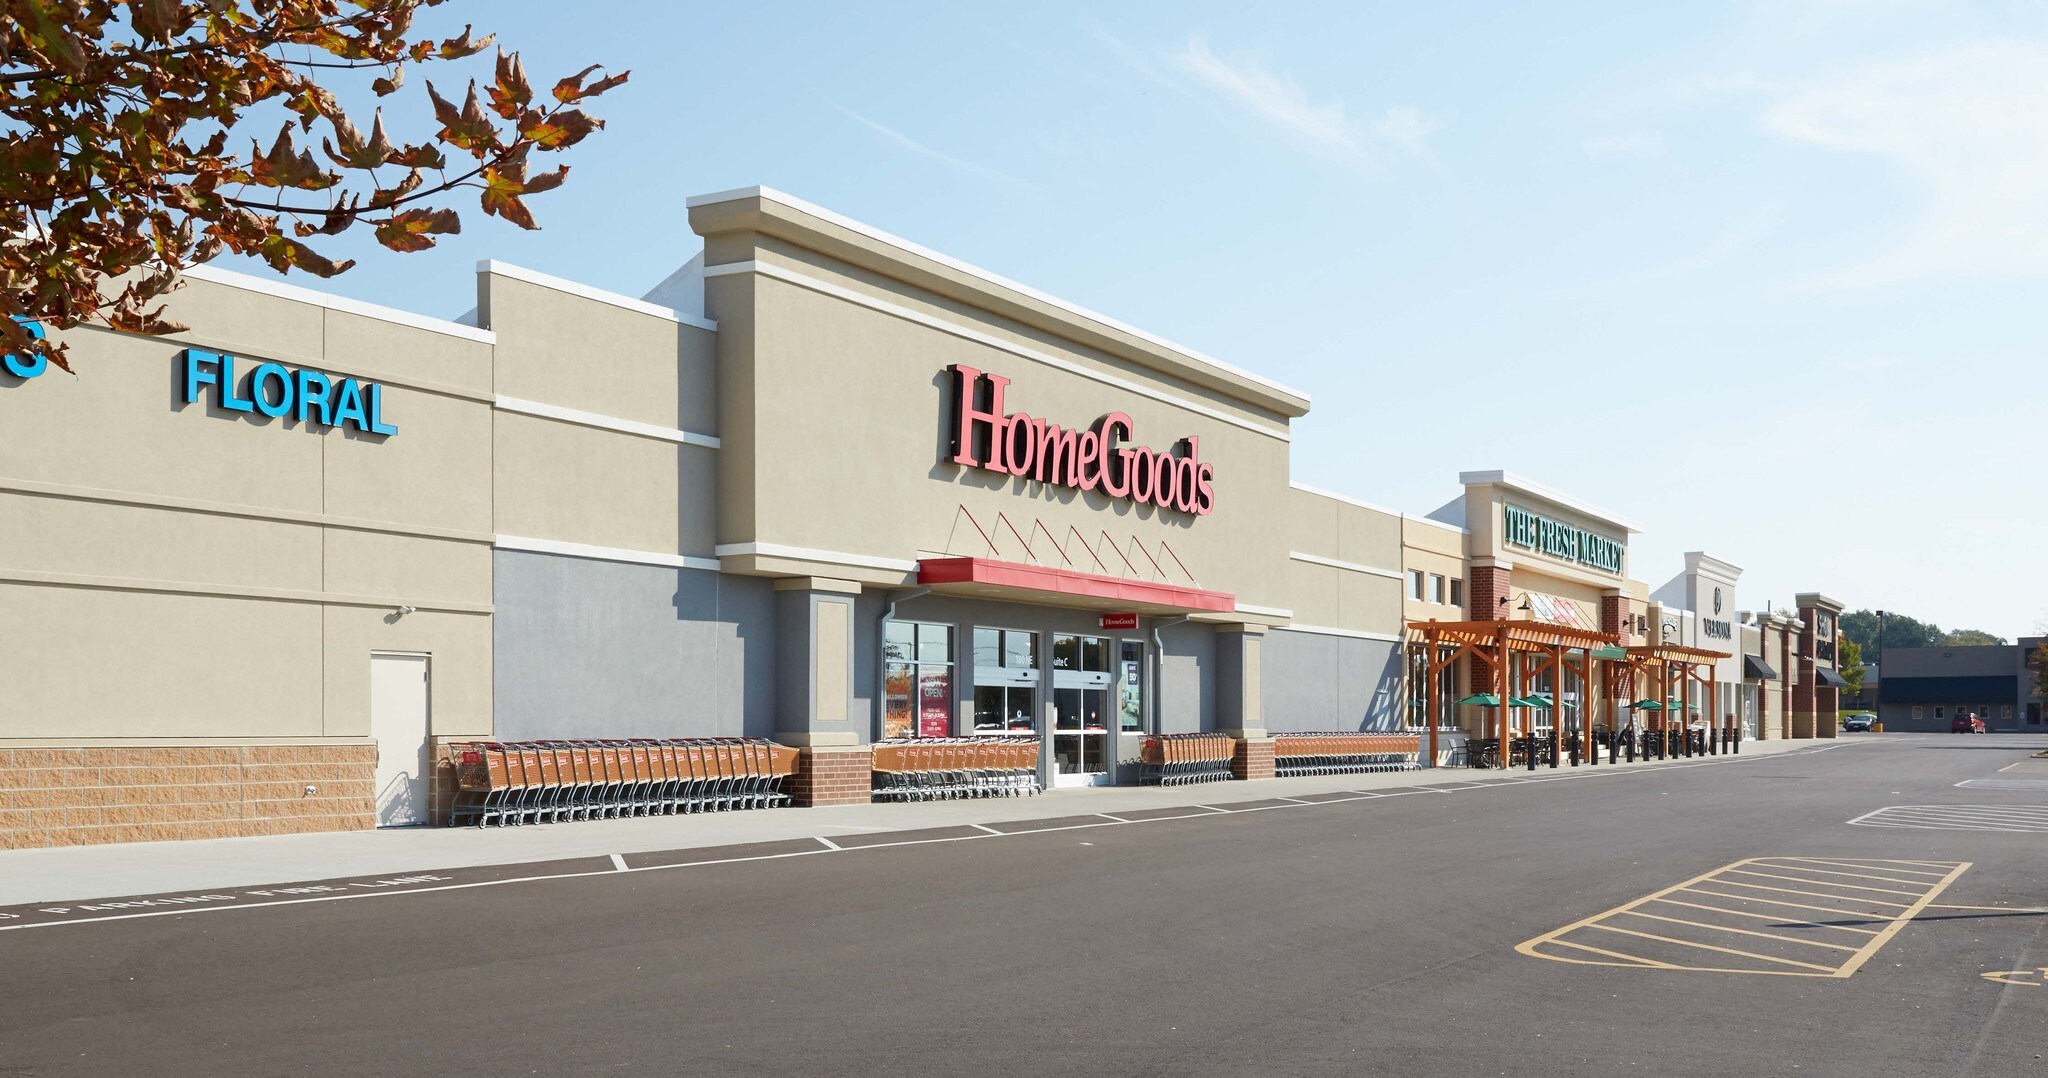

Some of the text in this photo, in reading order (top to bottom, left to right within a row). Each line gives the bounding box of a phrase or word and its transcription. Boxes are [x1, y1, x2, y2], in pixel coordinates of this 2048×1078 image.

[184, 348, 398, 436] FLORAL
[949, 364, 1214, 516] HomeGoods
[1505, 506, 1624, 577] THE FRESH MARKET
[1105, 618, 1135, 626] HomeGoods
[1053, 656, 1068, 667] uite C
[38, 875, 453, 915] PARKING FIRE LANE
